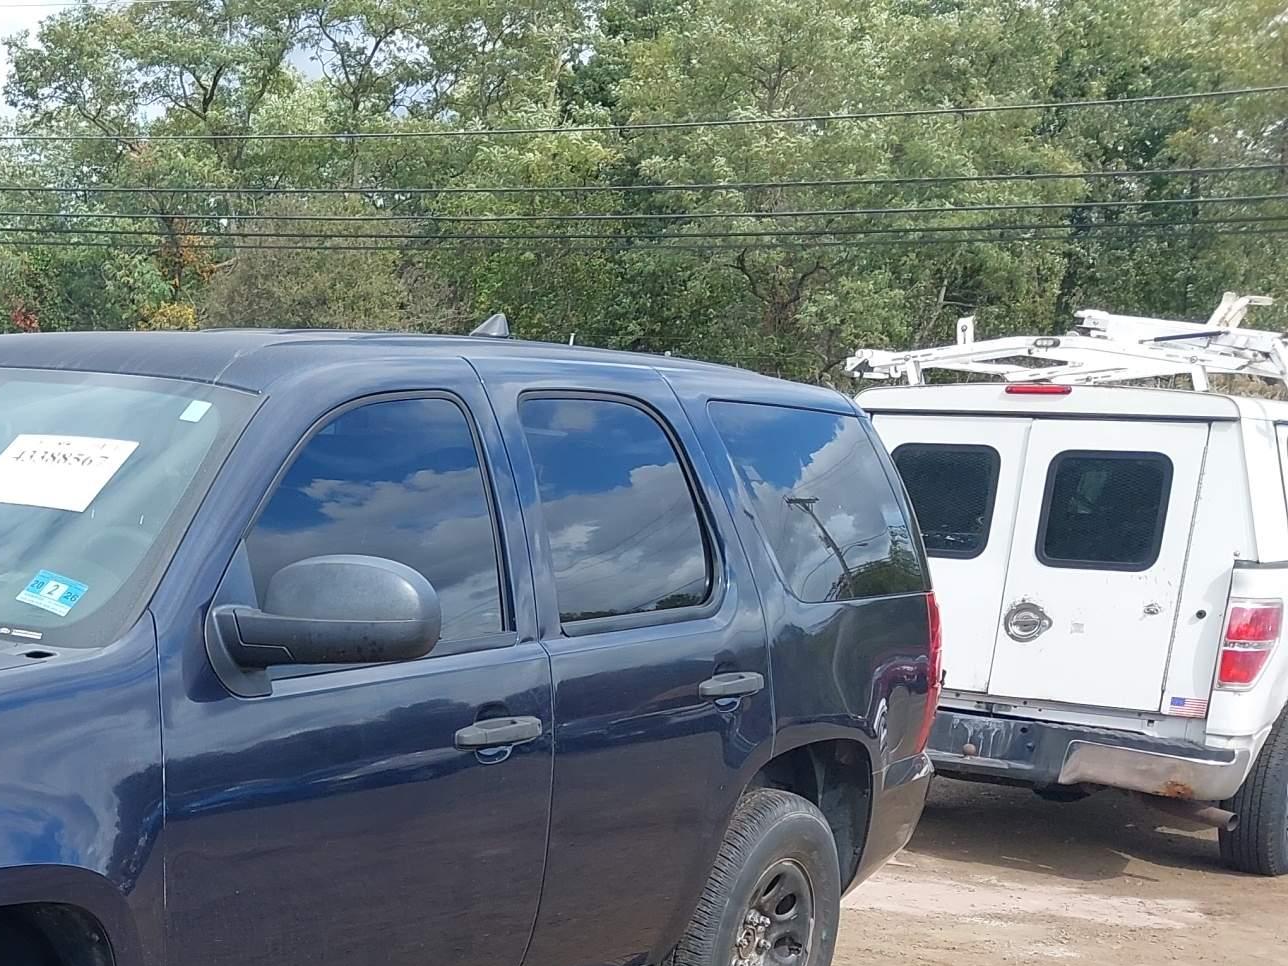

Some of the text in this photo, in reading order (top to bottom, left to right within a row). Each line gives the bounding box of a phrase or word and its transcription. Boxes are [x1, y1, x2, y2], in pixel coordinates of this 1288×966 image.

[30, 579, 45, 590] 20
[47, 583, 60, 596] 2
[64, 591, 79, 602] 26
